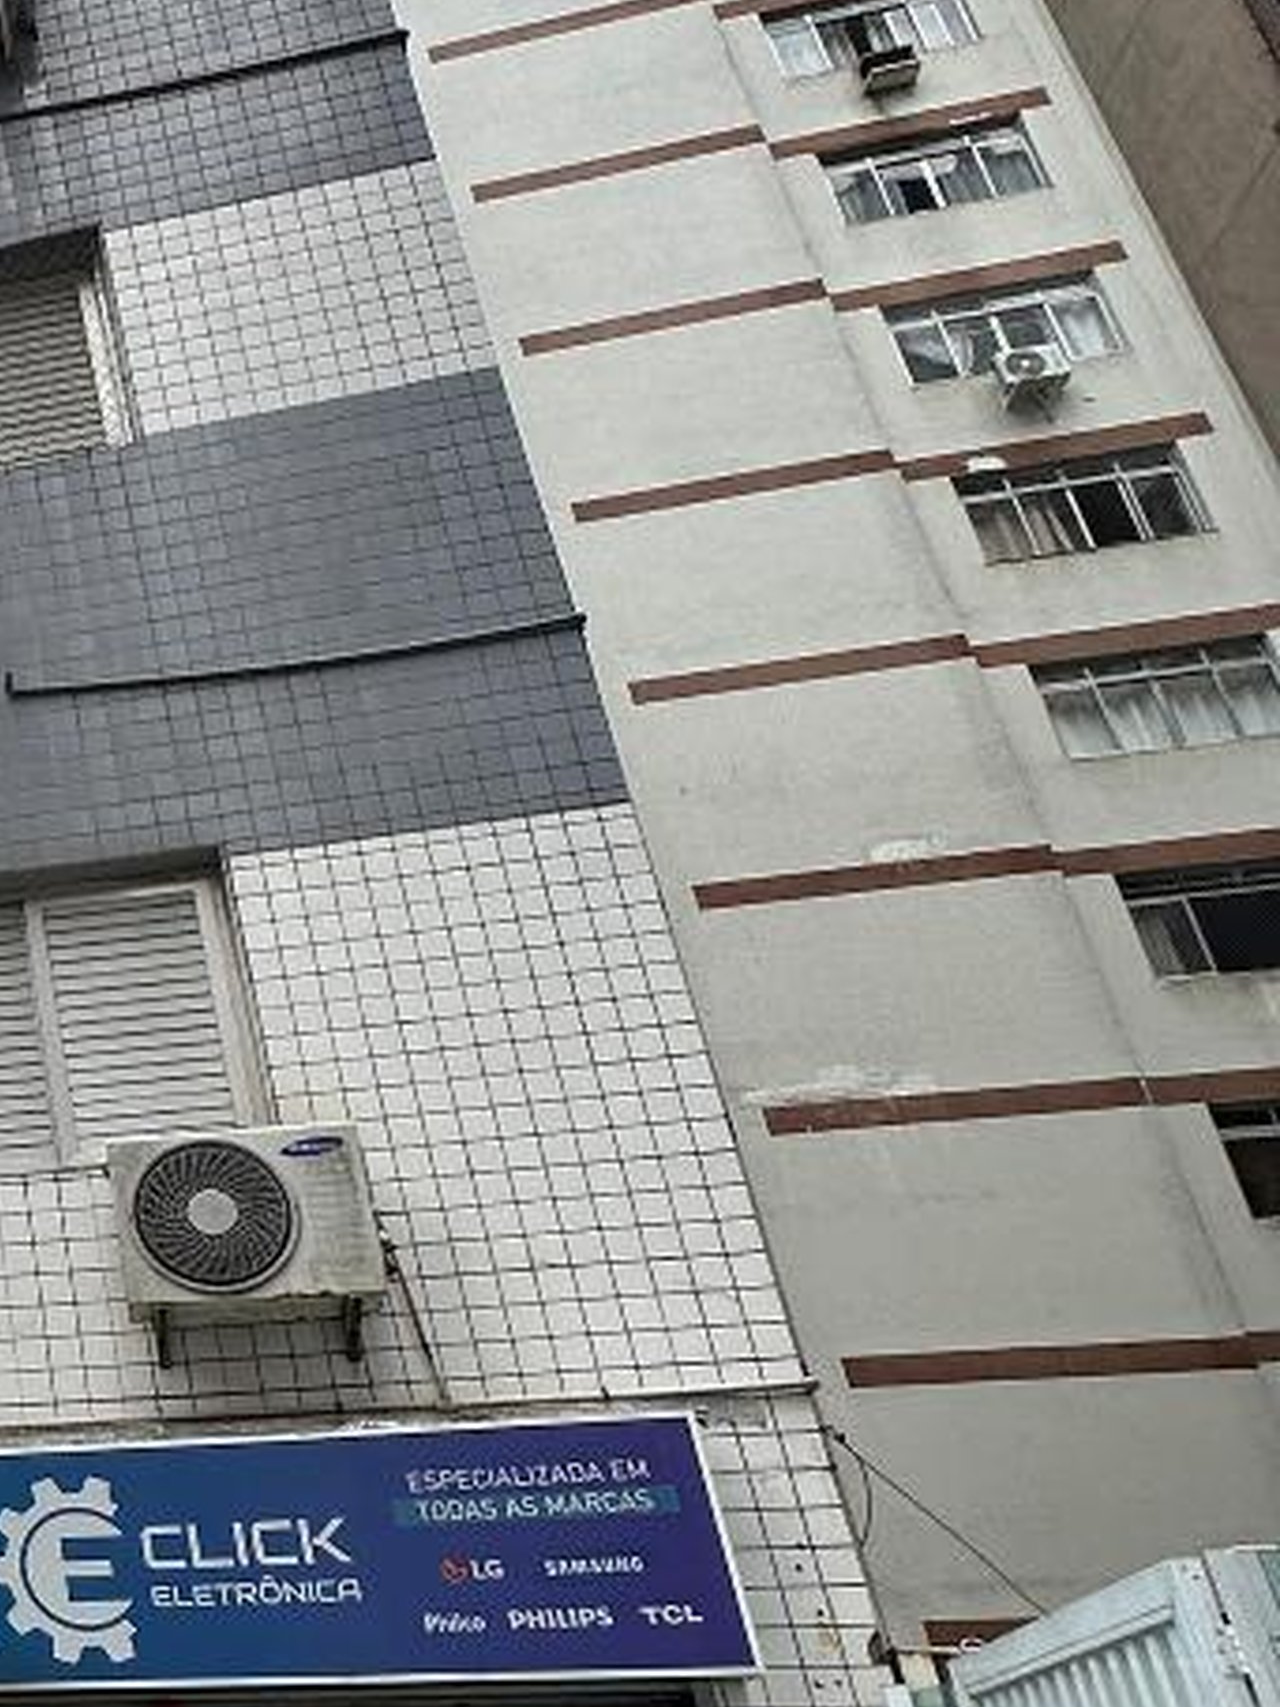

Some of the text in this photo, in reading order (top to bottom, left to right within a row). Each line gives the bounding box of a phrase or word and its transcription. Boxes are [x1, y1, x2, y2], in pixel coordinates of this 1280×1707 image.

[405, 1457, 651, 1494] ESPECIALIZADA EM
[417, 1487, 655, 1522] TODAS AS MARCAS
[140, 1515, 352, 1570] CLICK
[151, 1574, 363, 1609] ELETRÔNICA
[506, 1605, 615, 1632] PHILIPS
[638, 1603, 705, 1626] TCL
